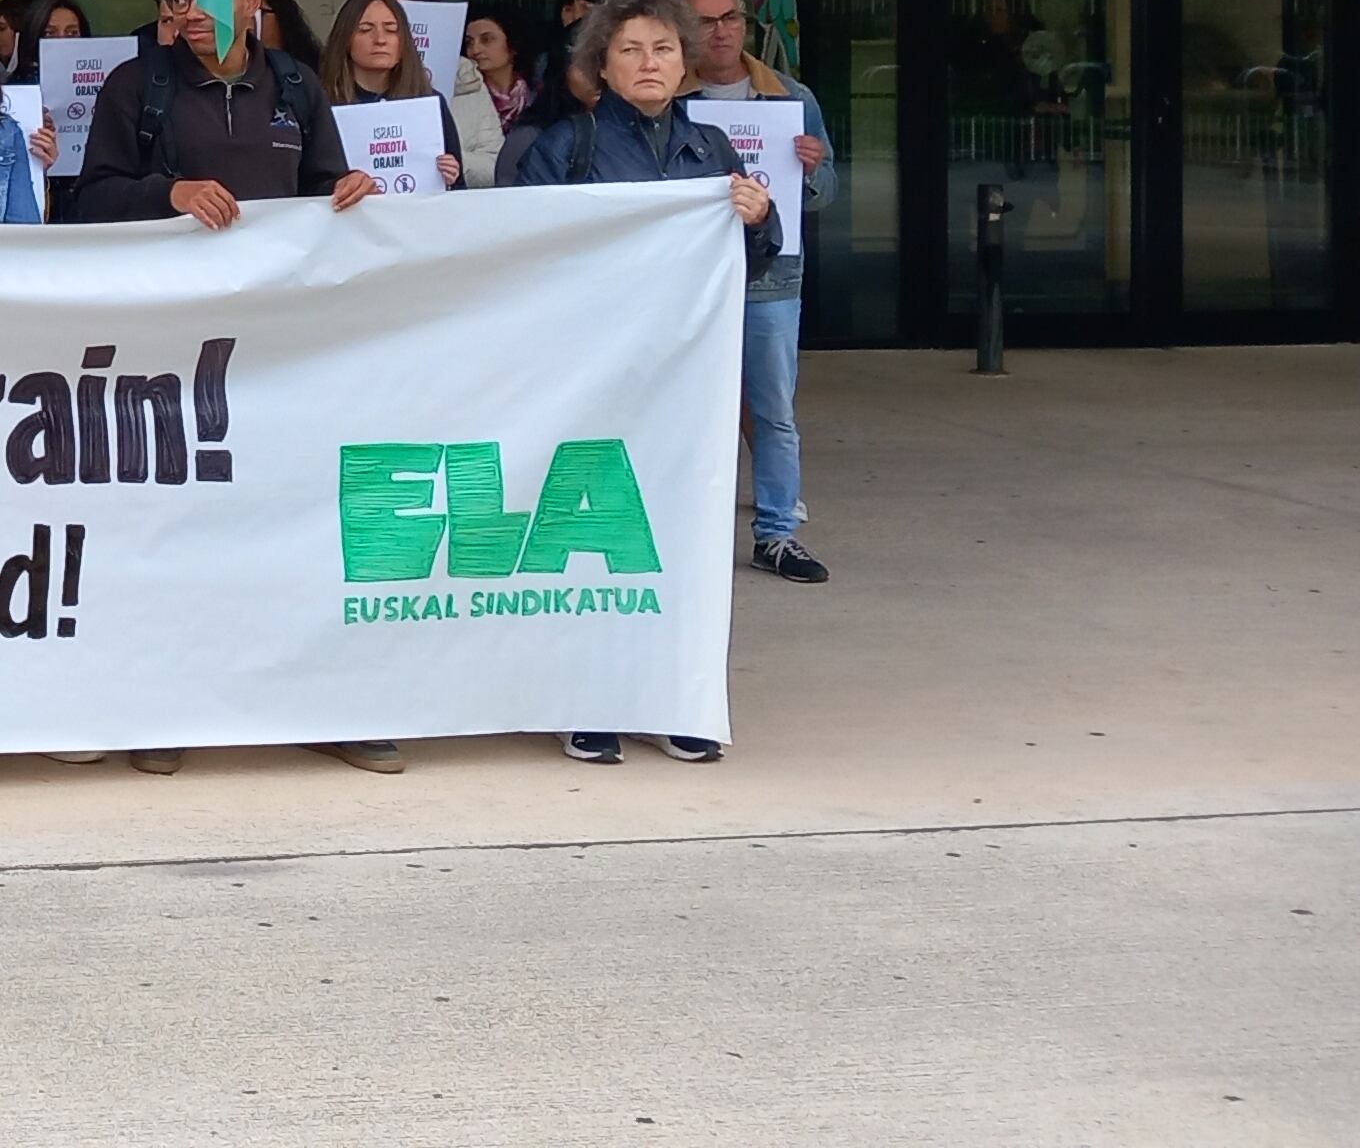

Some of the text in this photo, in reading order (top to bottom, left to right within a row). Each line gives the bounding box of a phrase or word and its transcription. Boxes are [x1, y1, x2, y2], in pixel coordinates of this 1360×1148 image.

[373, 125, 403, 140] ISRAELI
[369, 140, 407, 155] BOIKOTA
[373, 155, 404, 169] ORAIN!
[340, 439, 663, 582] ELA
[344, 587, 662, 624] EUSKAL SINDIKATUA
